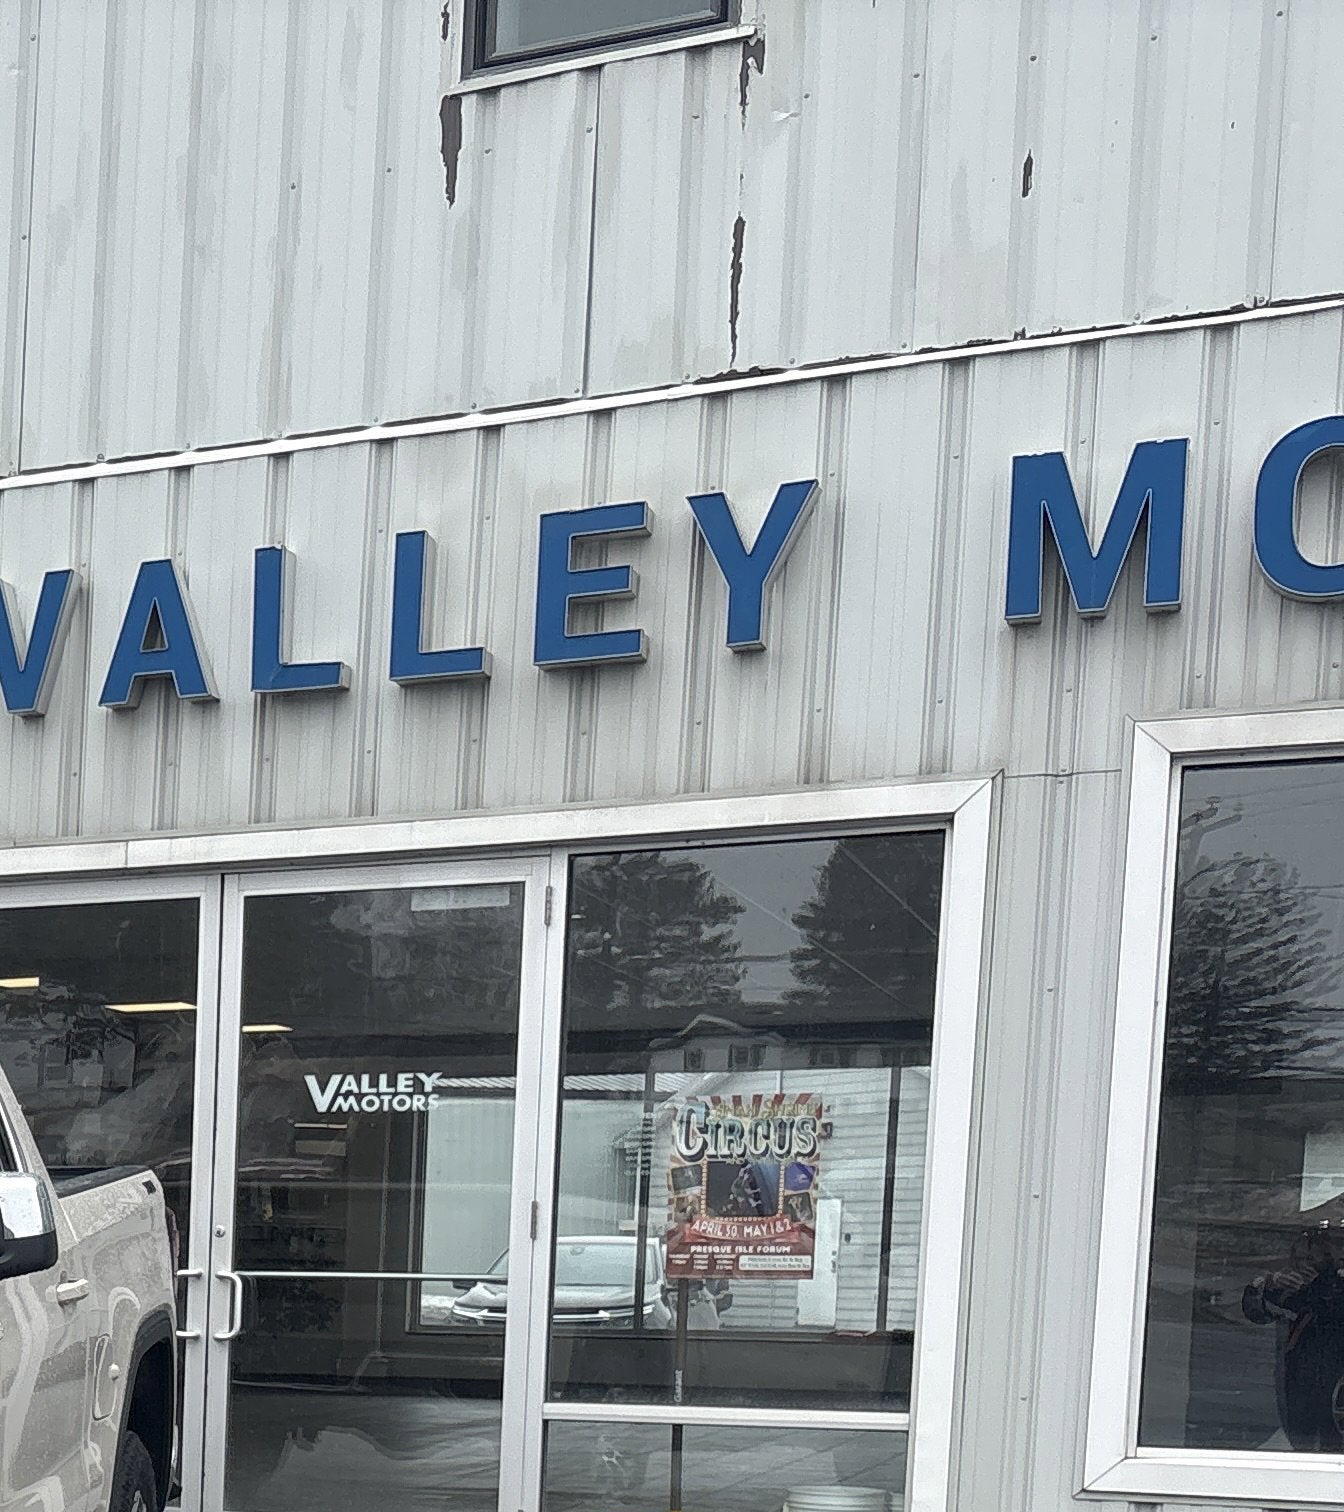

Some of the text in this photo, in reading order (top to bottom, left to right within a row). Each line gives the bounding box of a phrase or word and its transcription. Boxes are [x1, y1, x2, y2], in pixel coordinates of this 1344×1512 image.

[303, 1072, 443, 1113] VALLEY
[330, 1093, 440, 1113] MOTORS
[675, 1100, 819, 1163] CIRCUS
[691, 1220, 723, 1236] APRIL
[743, 1223, 768, 1238] MAY
[757, 1245, 791, 1254] FORUM
